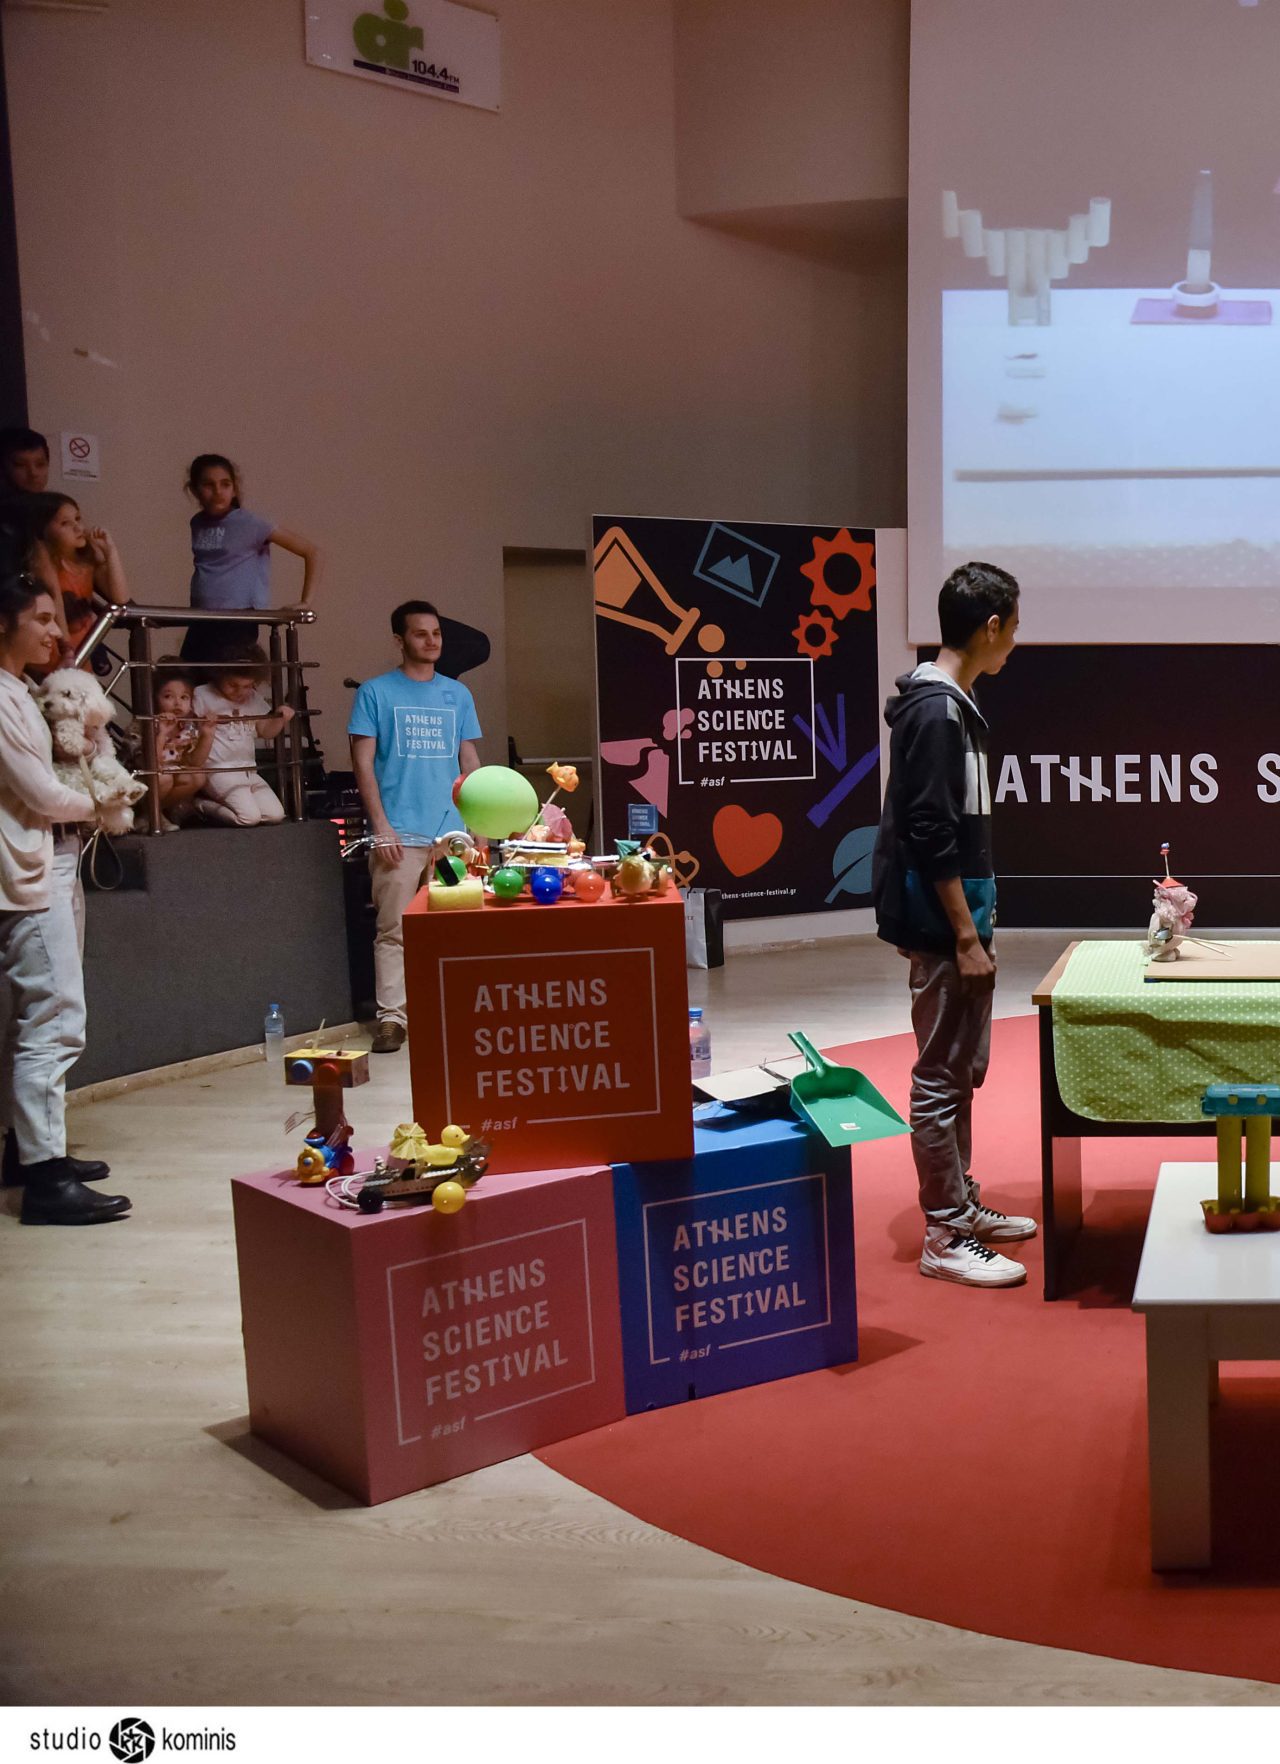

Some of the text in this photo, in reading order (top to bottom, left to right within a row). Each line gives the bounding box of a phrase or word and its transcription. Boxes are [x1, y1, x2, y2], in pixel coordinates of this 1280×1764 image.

[411, 59, 450, 81] 104.4
[698, 678, 784, 700] ATHENS
[405, 714, 442, 725] ATHENS
[697, 709, 786, 731] SCIENCE
[405, 727, 443, 738] SCIENCE
[406, 739, 446, 750] FESTIVAL
[698, 740, 798, 763] FESTIVAL
[700, 776, 725, 787] #asf
[994, 753, 1219, 804] ATHENS
[721, 888, 797, 900] thens-science-festival.gr
[473, 978, 608, 1013] ATHENS
[474, 1020, 611, 1057] SCIENCE
[476, 1062, 630, 1099] FESTIVAL
[481, 1116, 518, 1132] #asf
[673, 1206, 788, 1252] ATHENS
[673, 1245, 790, 1292] SCIENCE
[422, 1258, 546, 1318] ATHENS
[675, 1282, 807, 1333] FESTIVAL
[422, 1300, 550, 1361] SCIENCE
[679, 1344, 712, 1363] #asf
[425, 1339, 568, 1406] FESTIVAL
[431, 1416, 466, 1439] #asf
